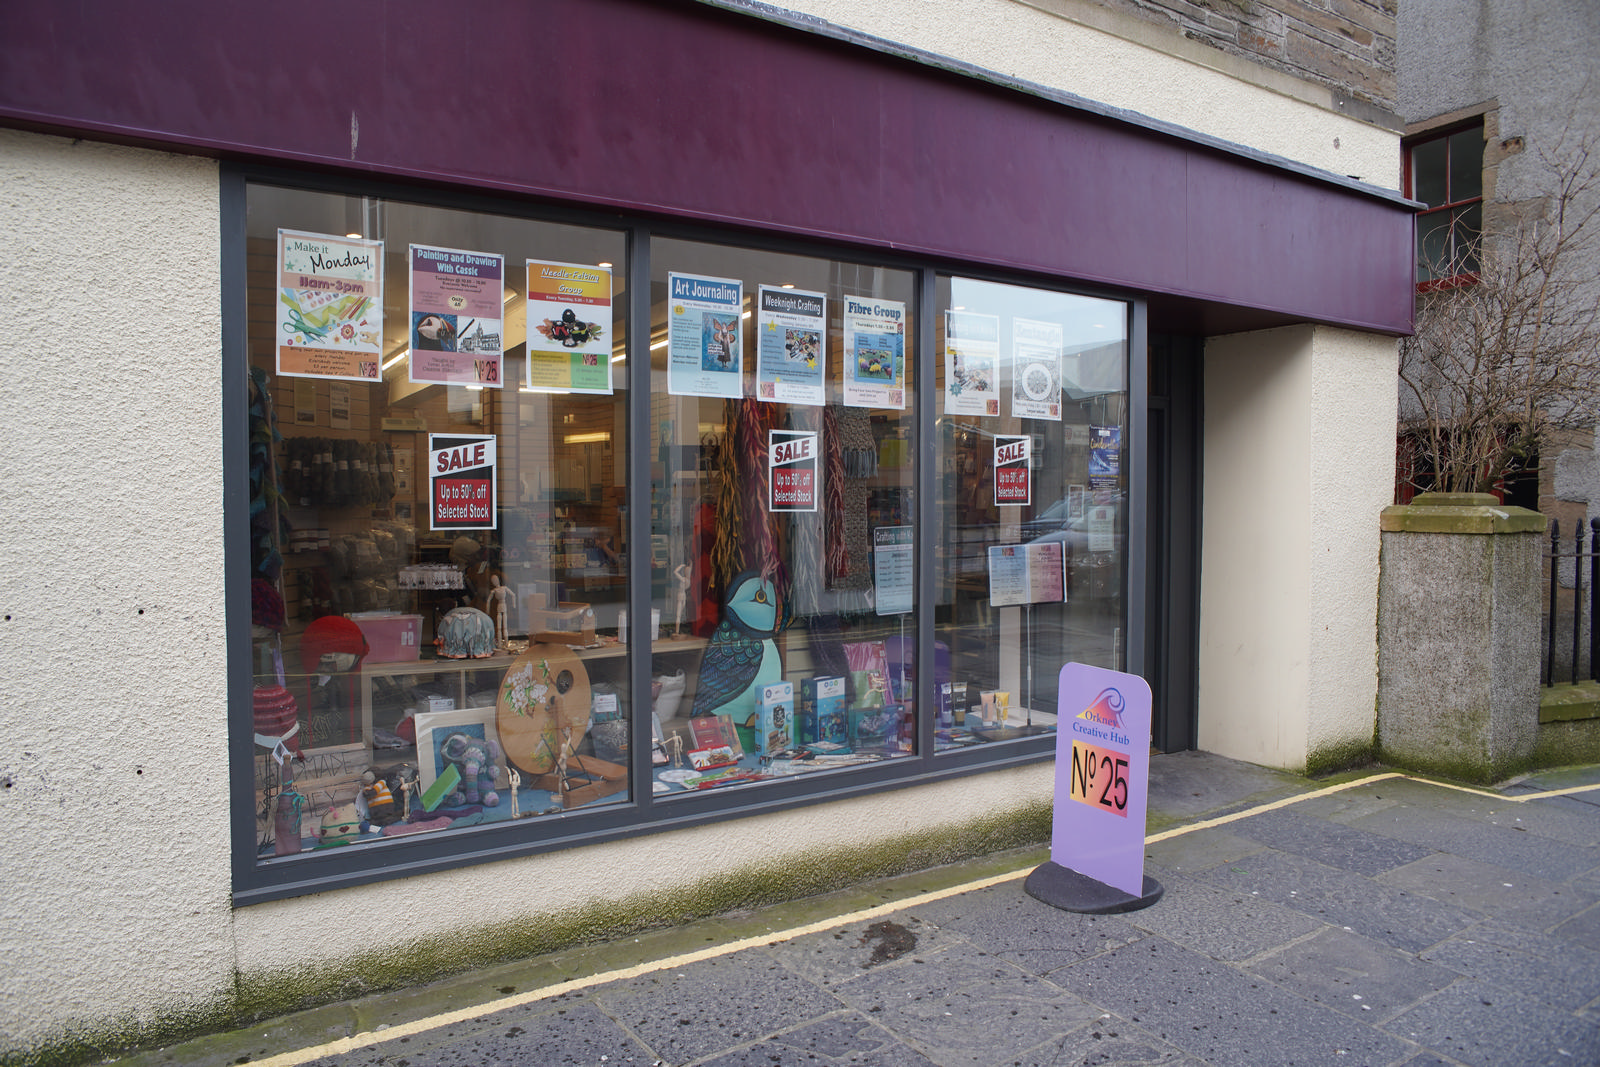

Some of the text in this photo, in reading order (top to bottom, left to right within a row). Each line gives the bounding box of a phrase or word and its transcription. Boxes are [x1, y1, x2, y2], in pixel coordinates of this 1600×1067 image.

[295, 242, 328, 254] Make it
[310, 250, 369, 274] Monday
[417, 249, 497, 267] Painting and Drawing
[437, 263, 454, 273] With
[541, 267, 600, 282] Needle-Felting
[300, 276, 364, 293] 11am-3pm
[559, 285, 583, 294] Group
[675, 280, 737, 305] Art Journaling
[765, 295, 821, 315] Weeknight Crafting
[848, 301, 872, 315] Fibre
[874, 305, 901, 321] Group
[368, 362, 377, 377] 25
[486, 361, 497, 381] 25
[437, 444, 485, 472] SALE
[775, 440, 810, 463] SALE
[998, 443, 1024, 463] SALE
[777, 473, 784, 488] Up
[785, 473, 790, 485] to
[792, 473, 802, 486] 50%
[999, 472, 1005, 485] Up
[441, 483, 487, 502] Up to 50% off
[775, 489, 812, 502] Selected Stock
[998, 486, 1026, 497] Selected Stock
[438, 503, 489, 518] Selected Stock
[1085, 710, 1118, 730] Orkney
[1073, 722, 1130, 746] Creative Hub
[1100, 756, 1128, 810] 25
